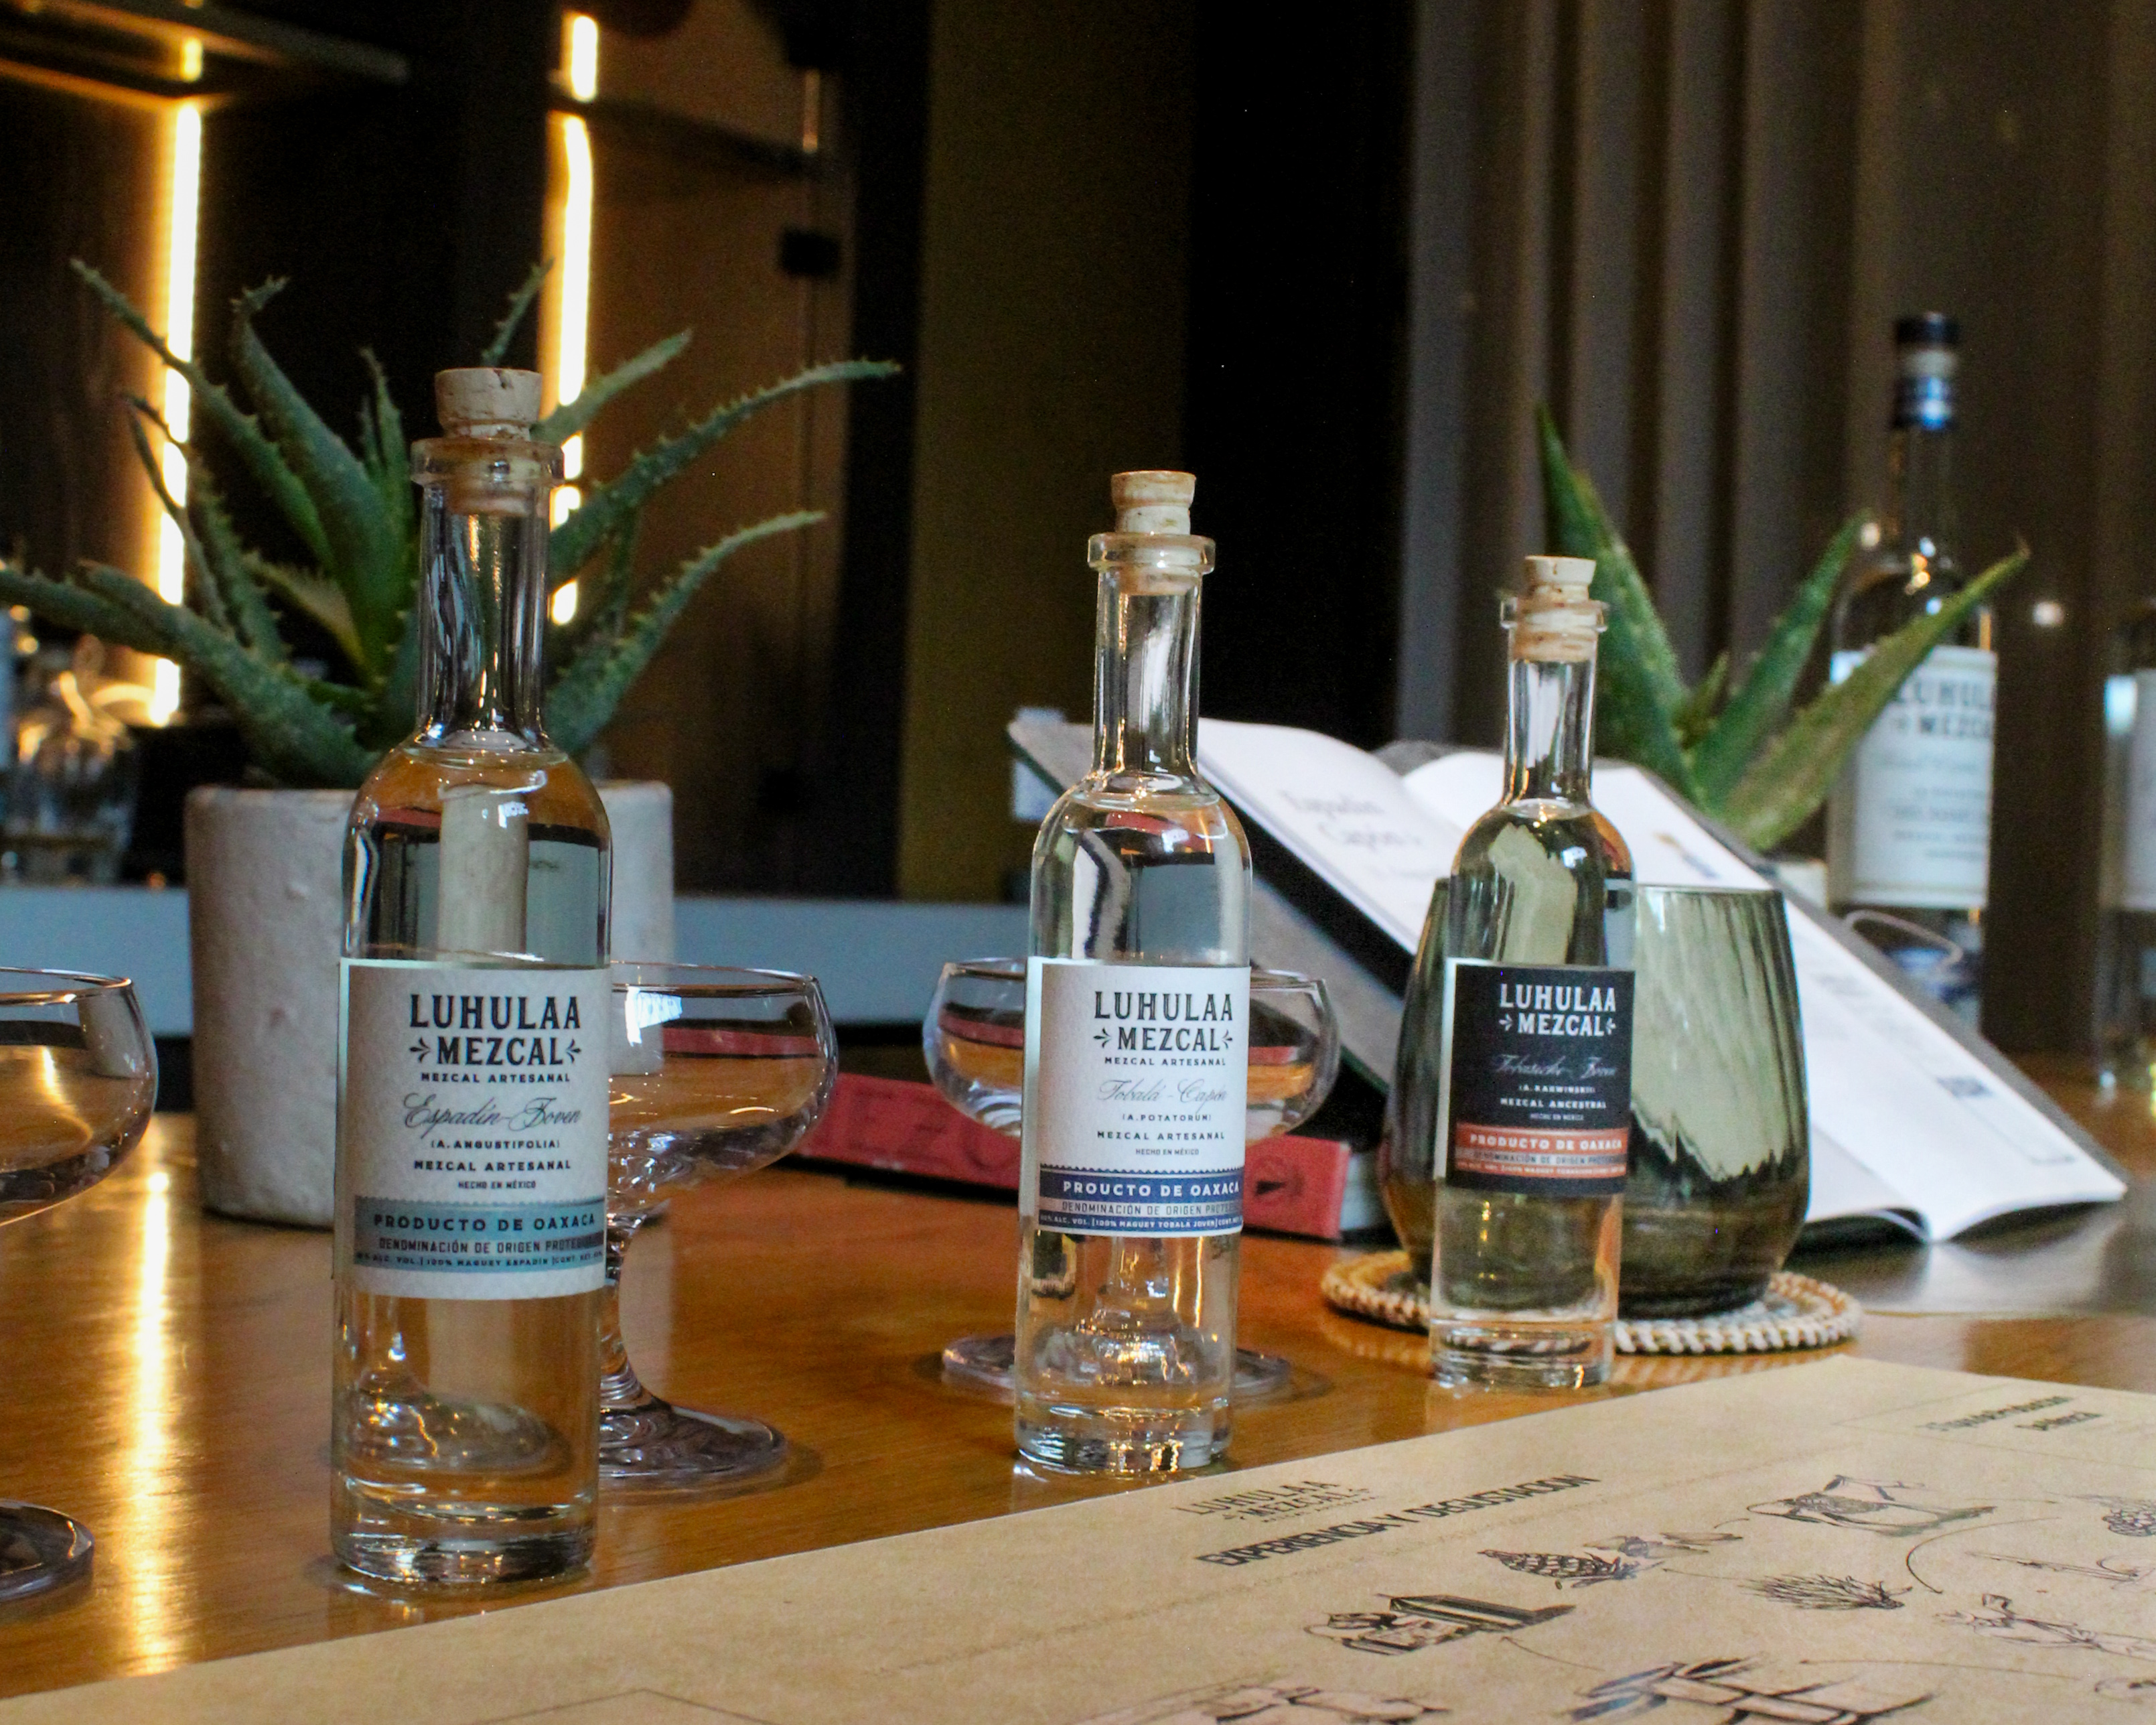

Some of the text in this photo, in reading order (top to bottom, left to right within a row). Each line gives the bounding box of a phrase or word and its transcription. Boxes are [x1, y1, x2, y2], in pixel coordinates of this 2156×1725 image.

[1500, 983, 1616, 1012] LUHULAA
[409, 994, 581, 1030] LUHULAA
[1094, 991, 1234, 1022] LUHULAA
[1518, 1013, 1605, 1036] MEZCAL
[1118, 1027, 1221, 1052] MEZCAL
[437, 1037, 564, 1066] MEZCAL
[1104, 1057, 1226, 1066] MEZCAL ARTESANAL
[421, 1073, 570, 1083] MEZCAL ARTESANAL
[1500, 1097, 1607, 1109] MEZCAL ANCESTRAL
[1097, 1131, 1225, 1140] MEZCAL ARTESANAL
[1470, 1133, 1622, 1151] PRODUCTO DE OAXACA
[1174, 1147, 1200, 1156] MÉXICO
[414, 1160, 571, 1171] MEZCAL ARTESANAL
[458, 1179, 536, 1189] HECHO EN MÉXICO
[1063, 1180, 1239, 1197] PROUCTO DE OAXACA
[1062, 1200, 1141, 1215] DENOMINACIÓN
[1147, 1205, 1159, 1215] DE
[1166, 1204, 1202, 1215] ORIGEN
[373, 1213, 595, 1231] PRODUCTO DE OAXACA
[379, 1237, 468, 1253] DENOMINACIÓN
[474, 1241, 490, 1253] DE
[497, 1239, 541, 1253] ORIGEN
[1171, 1480, 1342, 1516] LUHULAA
